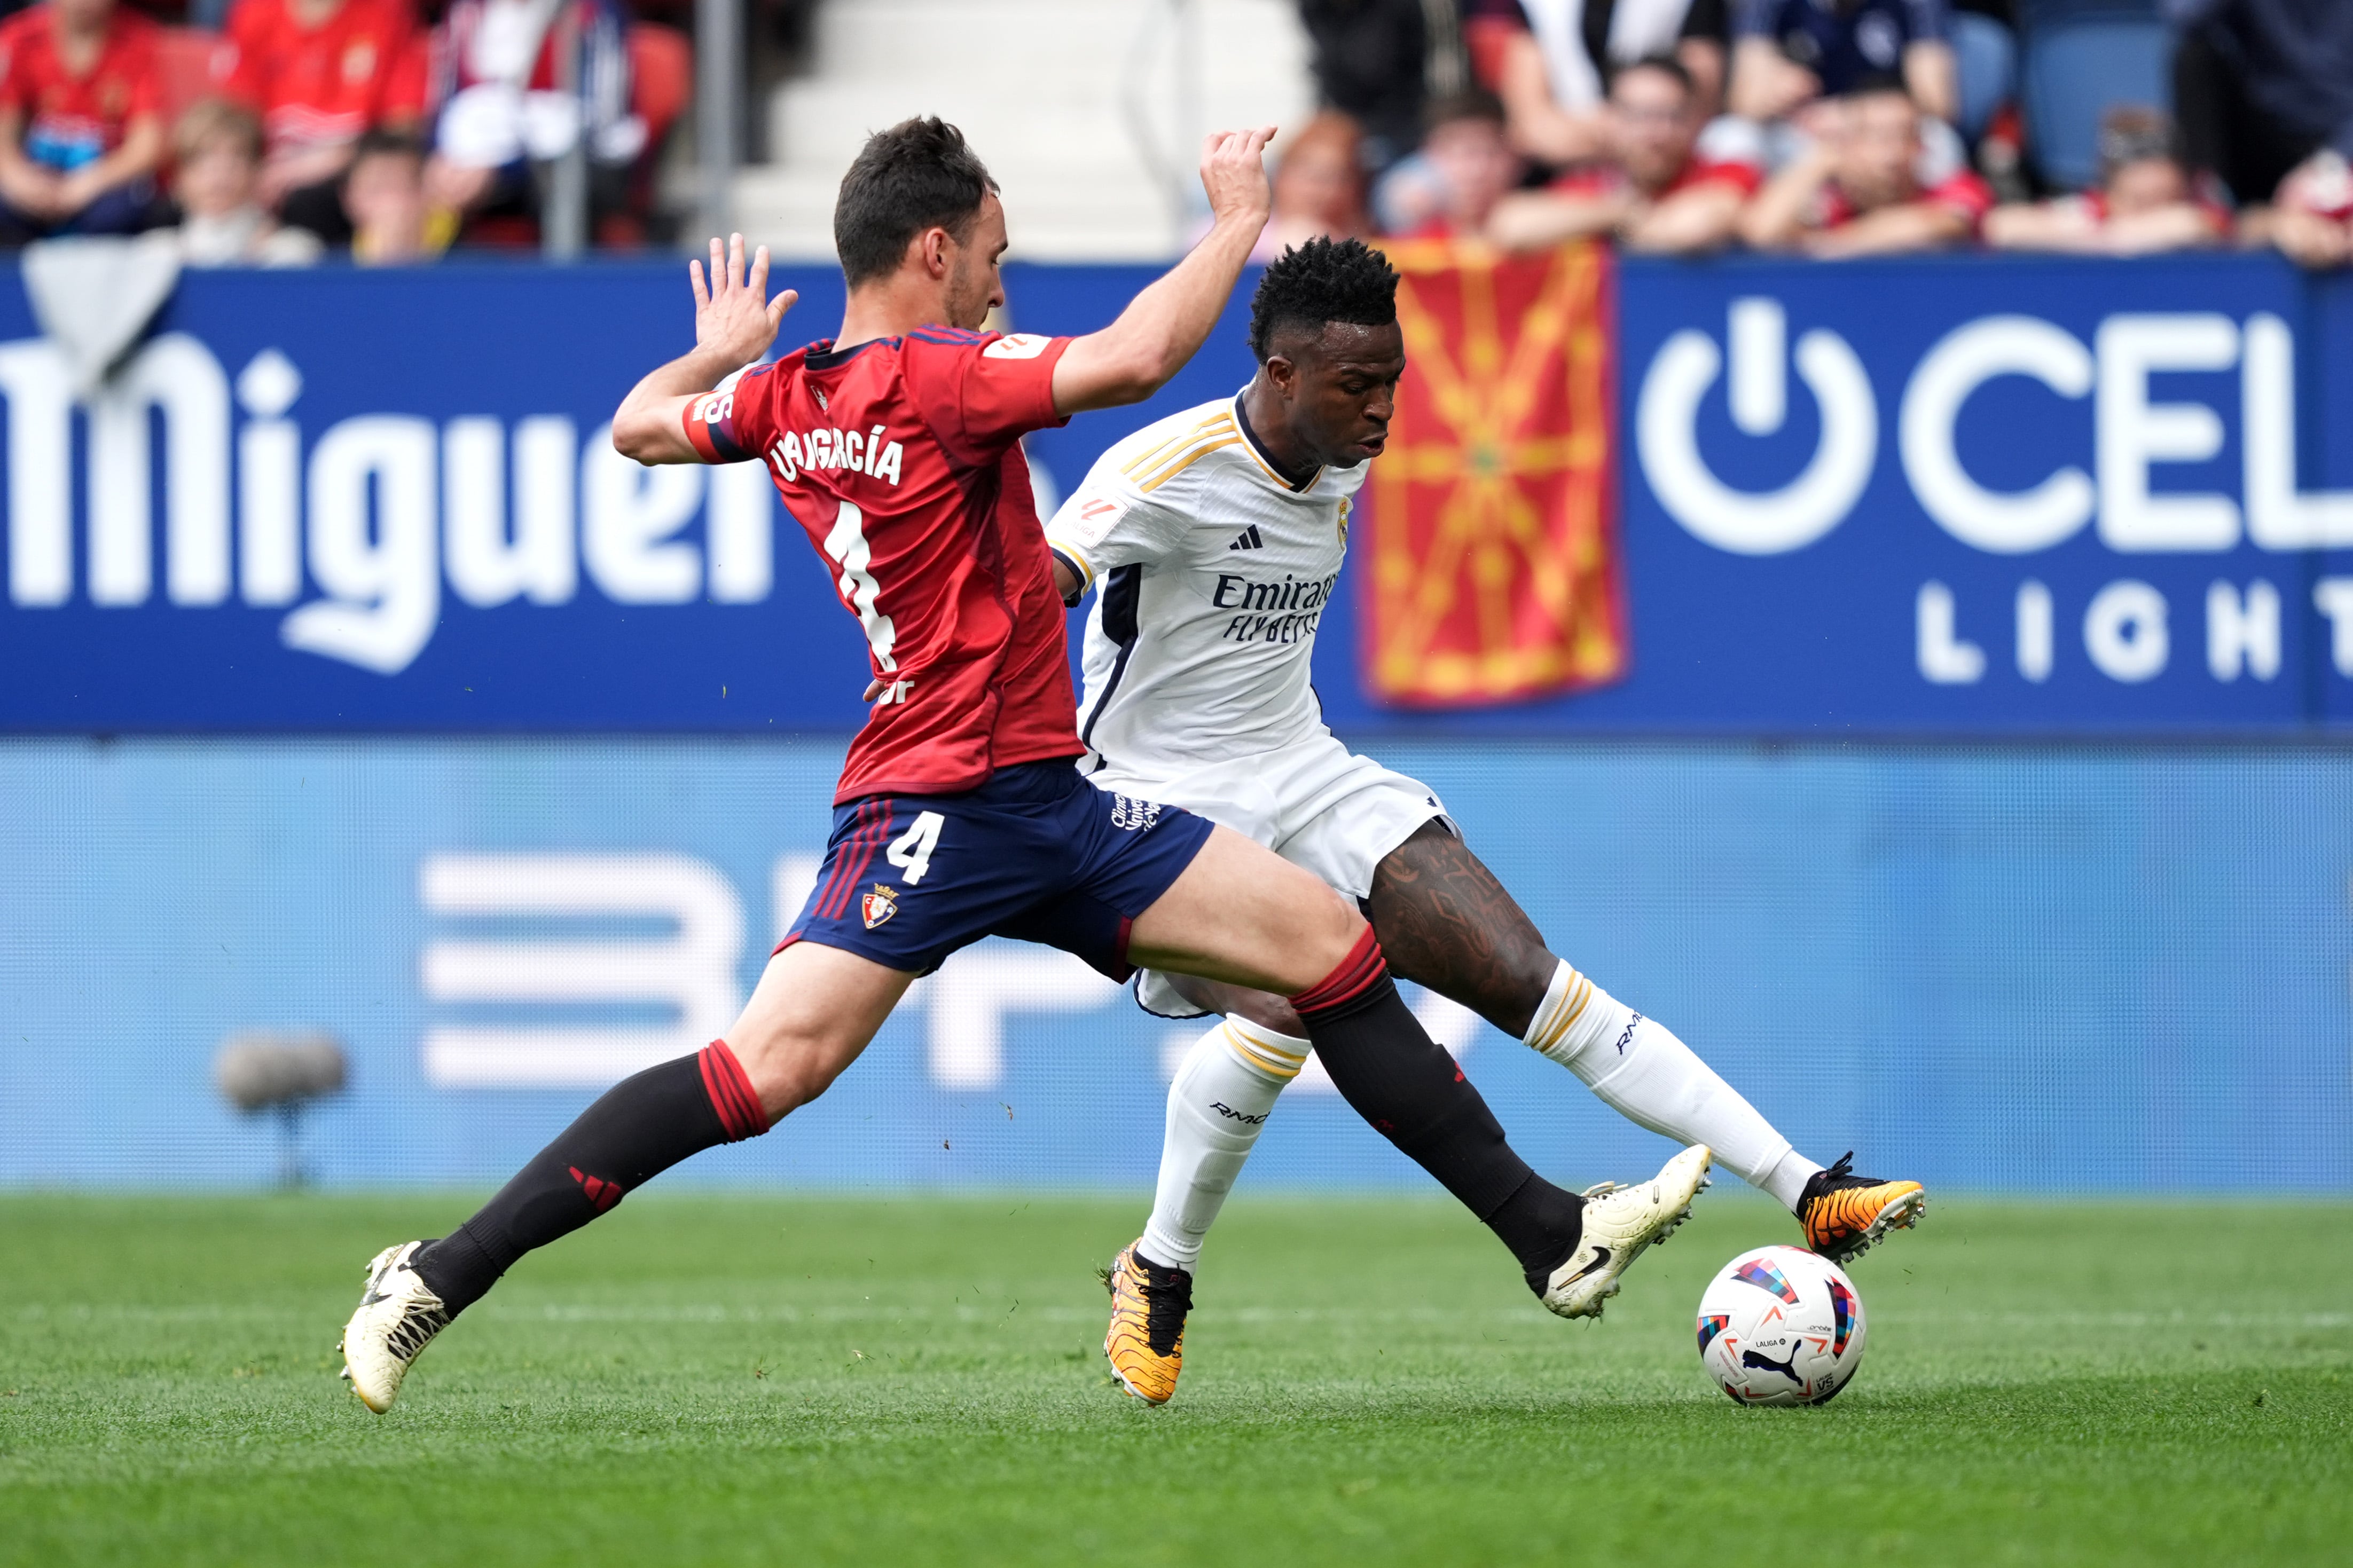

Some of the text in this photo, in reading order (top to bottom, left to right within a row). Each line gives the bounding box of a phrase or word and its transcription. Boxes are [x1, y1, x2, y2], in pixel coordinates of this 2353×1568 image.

[0, 329, 775, 676] Miguel
[1213, 574, 1339, 609] Emirate
[1223, 616, 1268, 642] FLY
[887, 811, 945, 885] 4
[1756, 1340, 1778, 1348] LALIGA
[1817, 1376, 1834, 1391] VS
